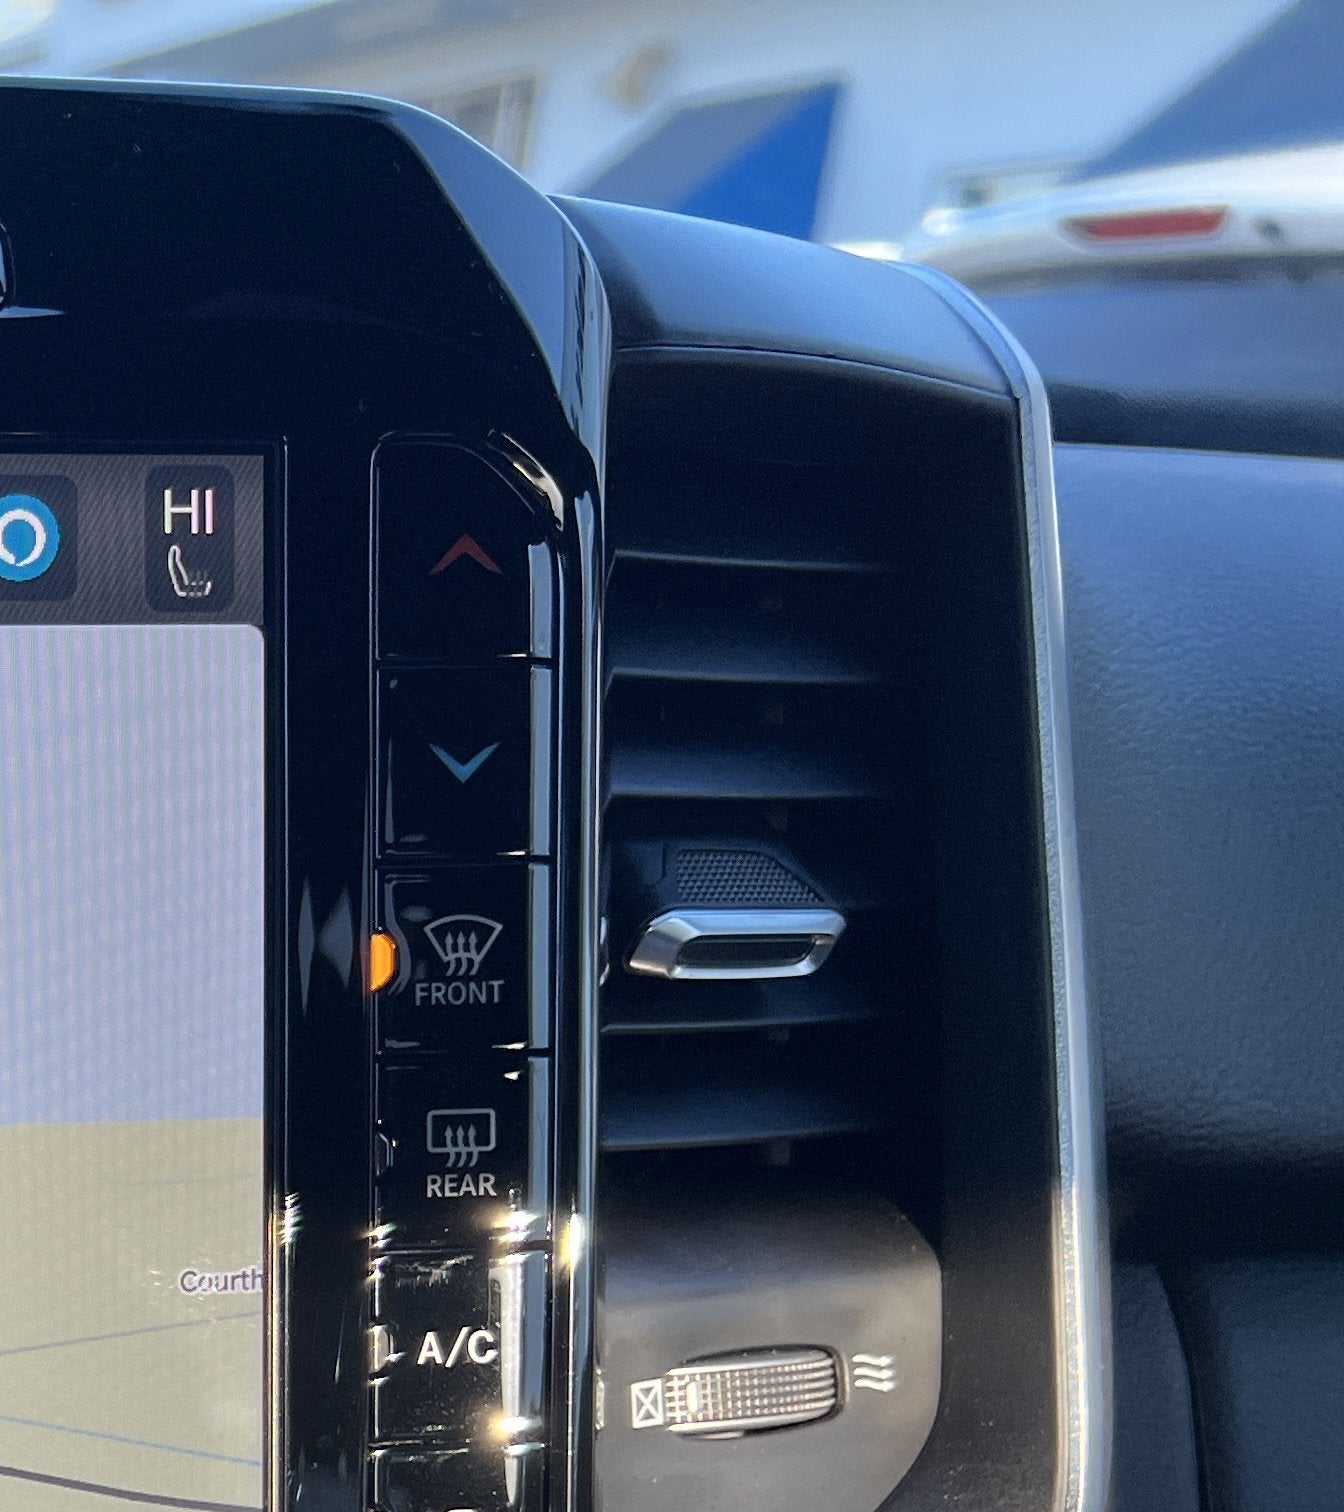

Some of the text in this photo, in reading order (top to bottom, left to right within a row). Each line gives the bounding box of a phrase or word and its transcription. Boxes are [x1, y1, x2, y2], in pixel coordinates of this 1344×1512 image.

[165, 489, 212, 533] HI
[416, 980, 504, 1005] FRONT
[427, 1174, 497, 1197] REAR
[418, 1327, 498, 1367] A/C
